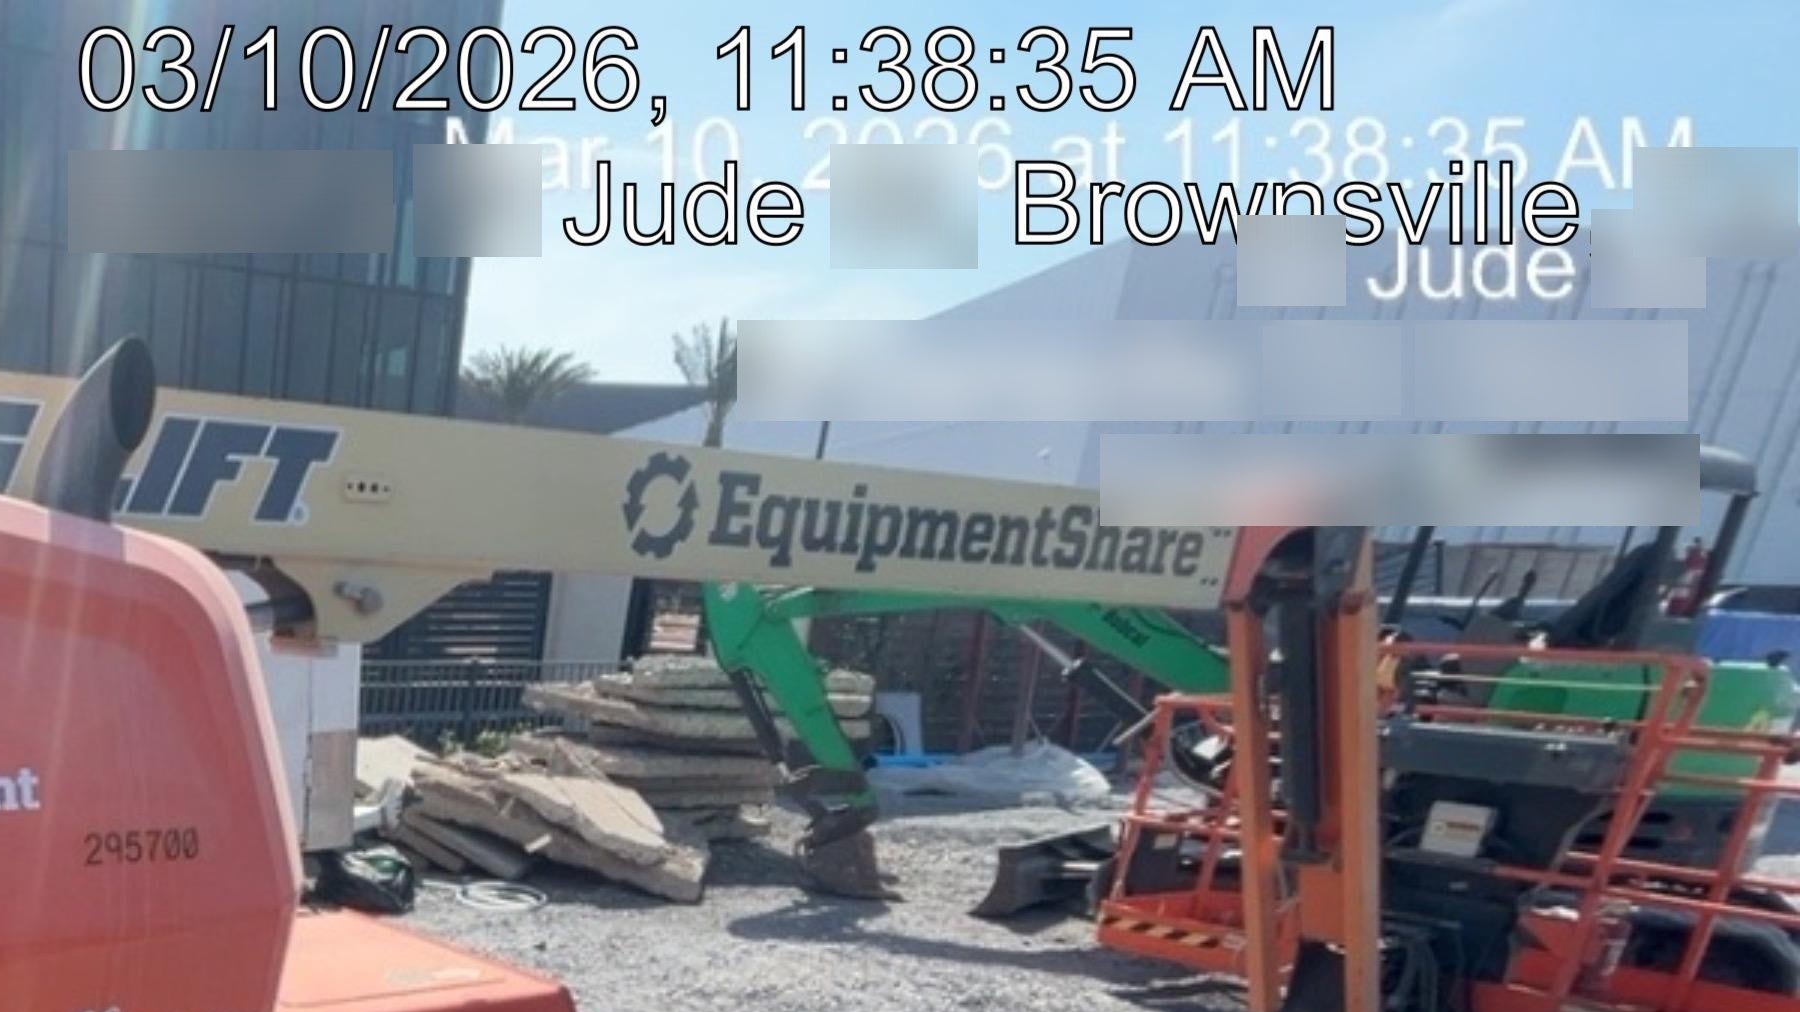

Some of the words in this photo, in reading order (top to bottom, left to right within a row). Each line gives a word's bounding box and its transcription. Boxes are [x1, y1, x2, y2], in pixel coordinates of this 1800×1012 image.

[112, 414, 342, 524] IFT
[707, 468, 1204, 577] EquipmentShare
[83, 827, 200, 867] 295700
